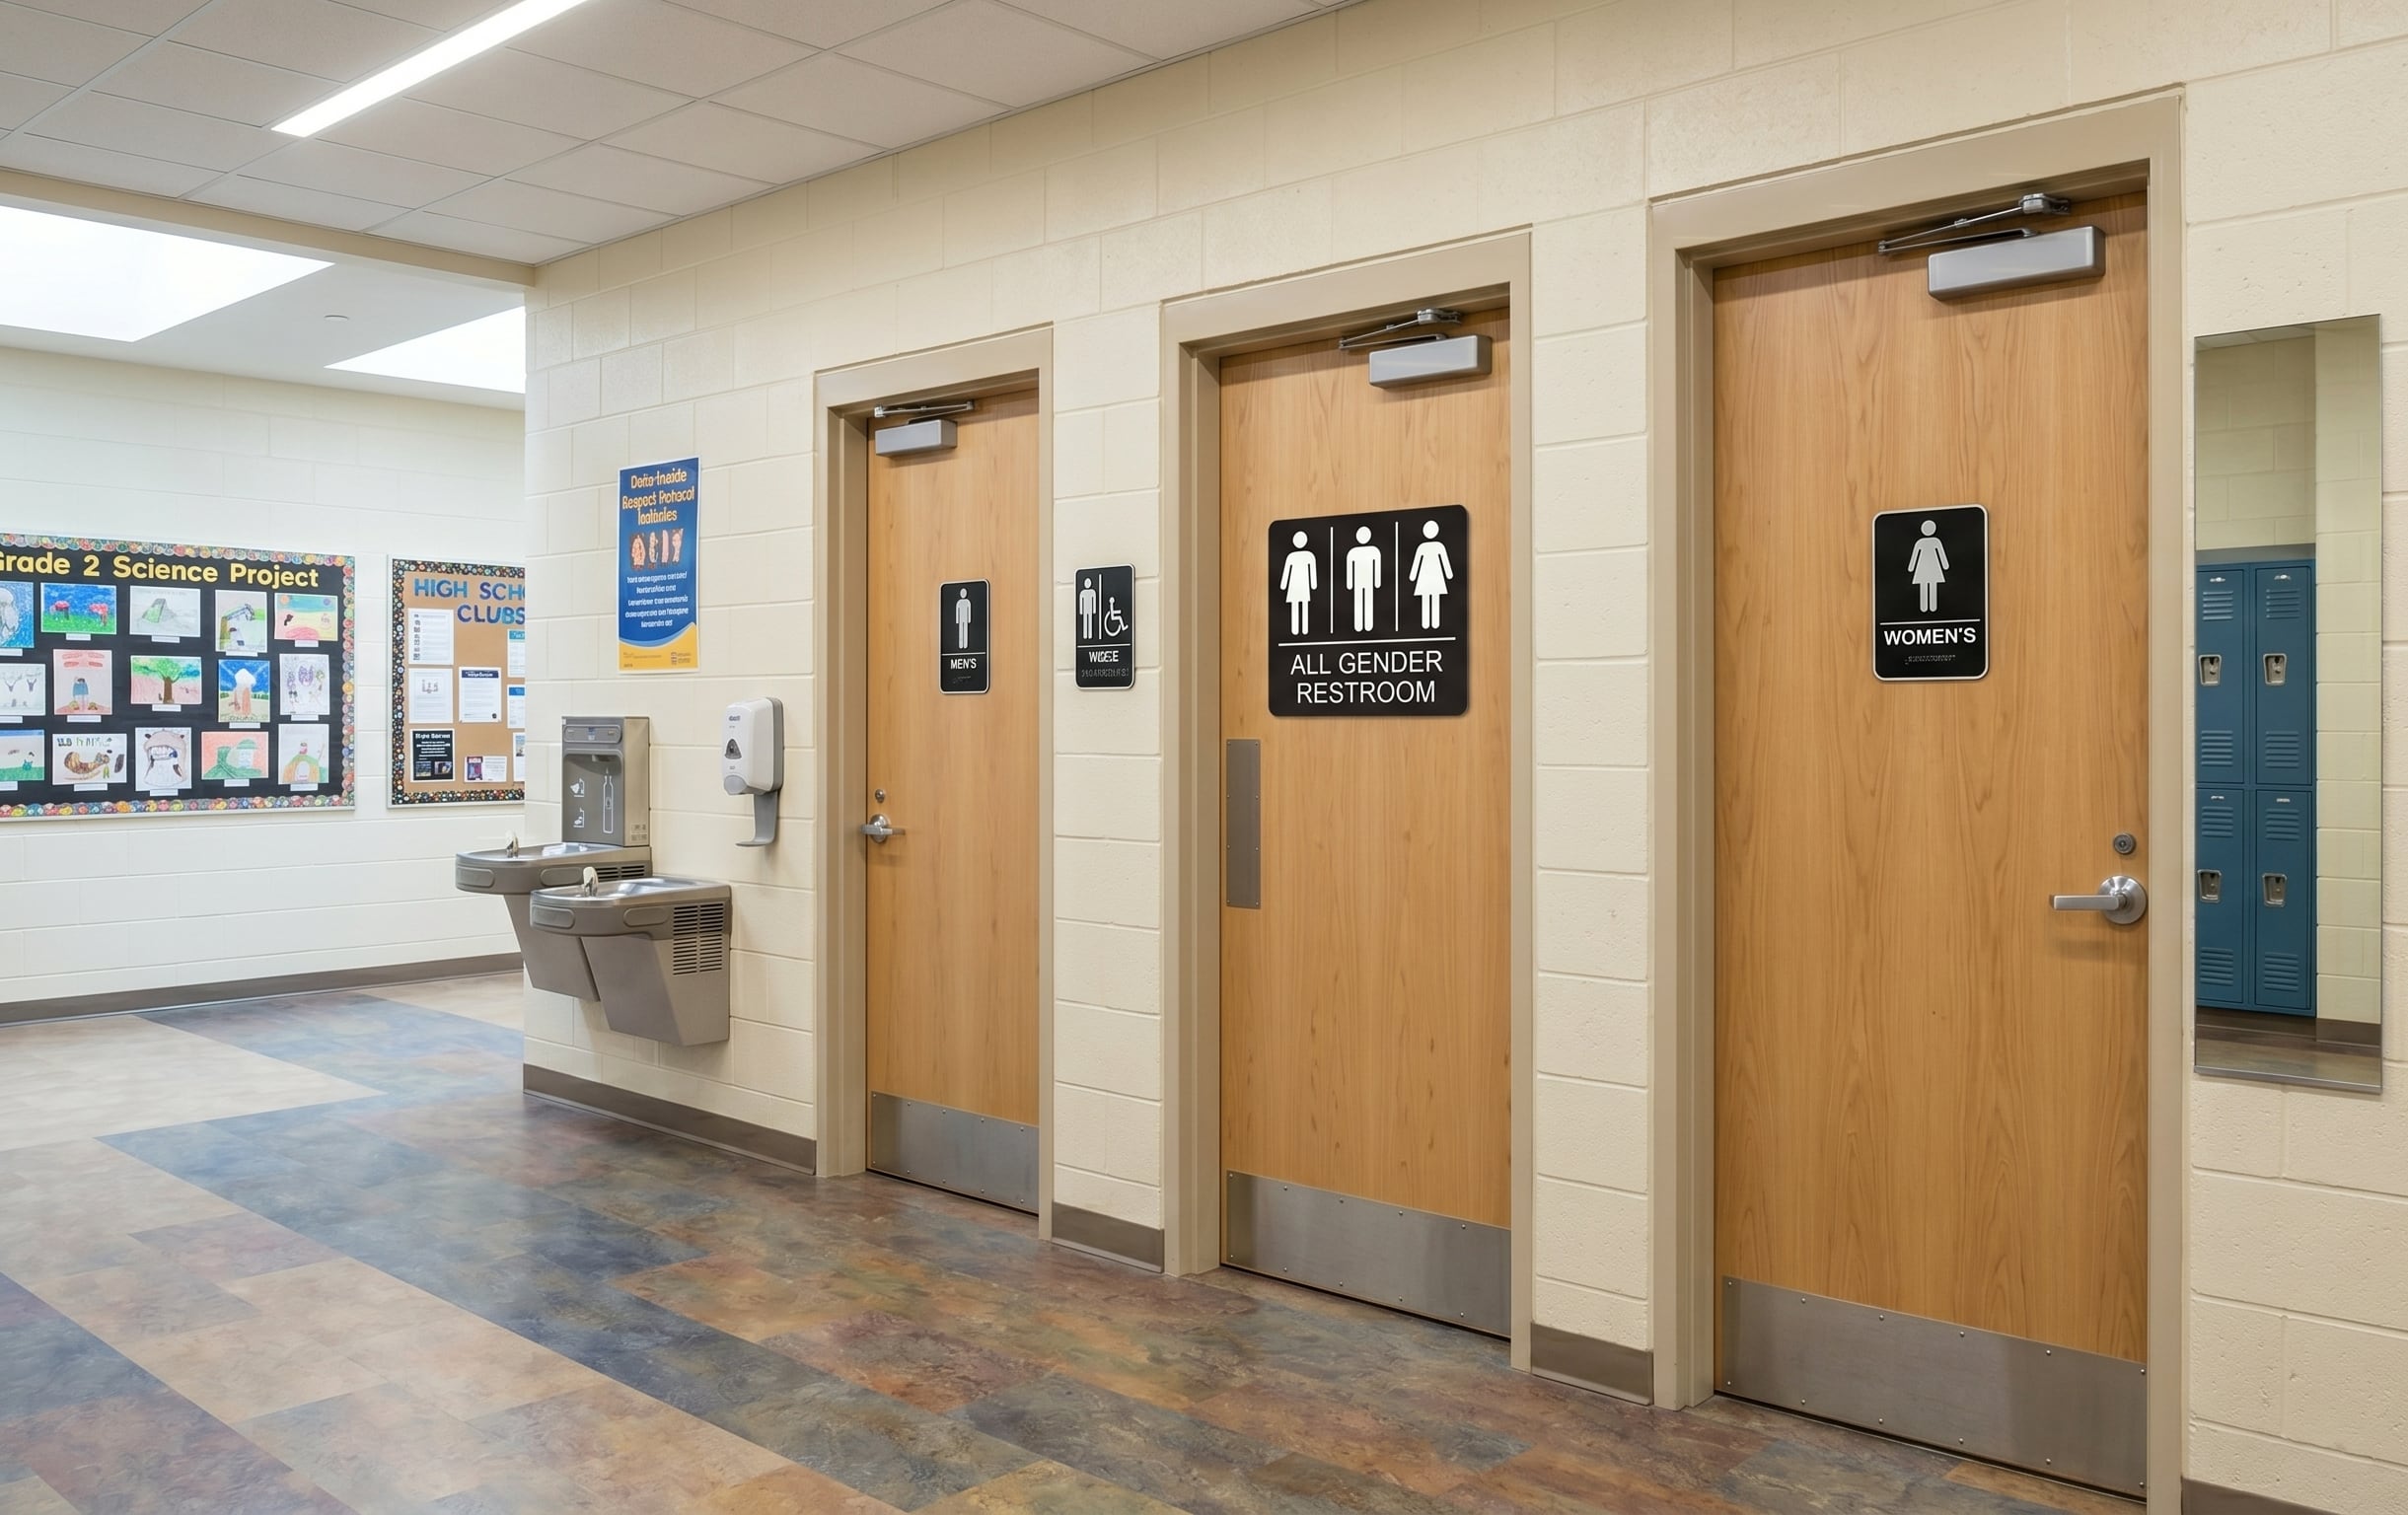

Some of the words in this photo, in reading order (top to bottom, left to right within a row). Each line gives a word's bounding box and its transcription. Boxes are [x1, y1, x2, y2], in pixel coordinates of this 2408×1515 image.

[83, 554, 101, 577] 2
[112, 554, 218, 582] Science
[230, 562, 319, 590] Project
[414, 578, 468, 598] HIGH
[479, 581, 525, 601] SCH
[457, 604, 525, 624] CLUBS
[1883, 627, 1977, 646] WOMEN'S
[950, 657, 977, 670] MEN'S
[1290, 653, 1332, 675] ALL
[1339, 650, 1443, 674] GENDER
[1297, 681, 1435, 704] RESTROOM
